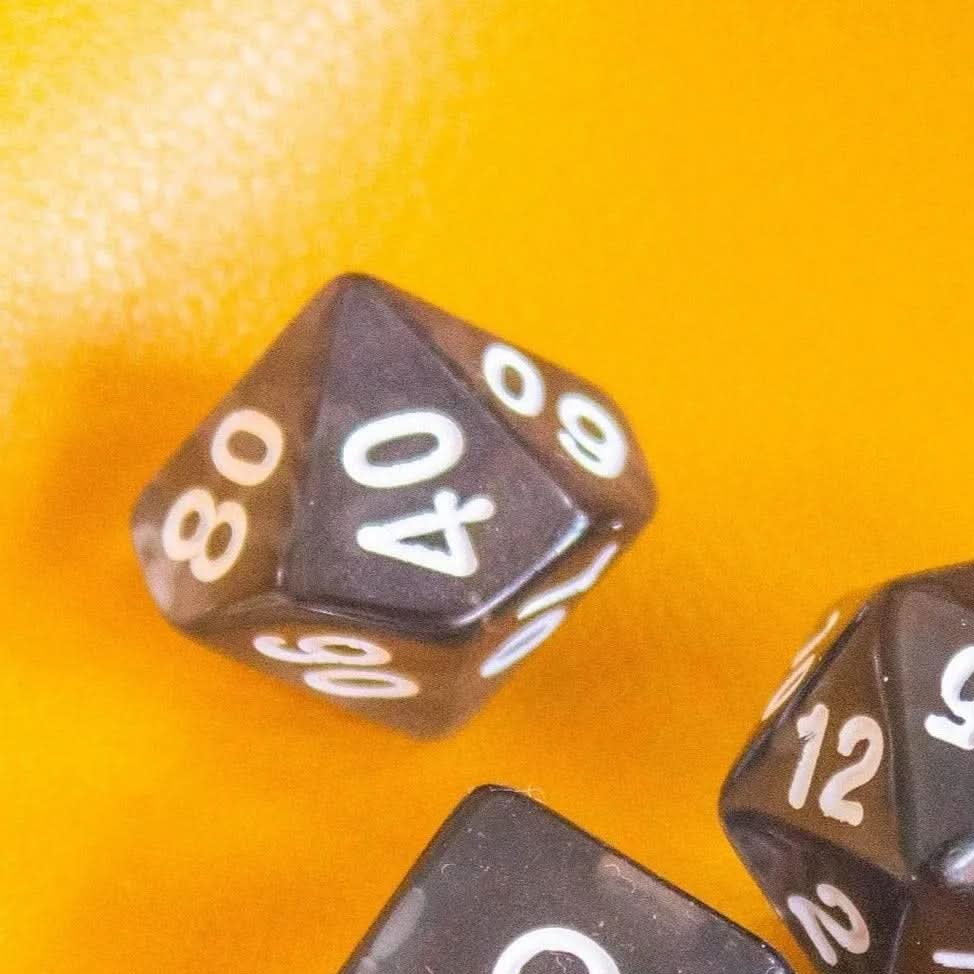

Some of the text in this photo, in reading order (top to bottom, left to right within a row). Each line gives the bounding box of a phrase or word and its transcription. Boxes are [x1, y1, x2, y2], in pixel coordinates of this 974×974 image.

[162, 408, 283, 583] 80
[342, 411, 494, 577] 40
[788, 704, 883, 826] 12
[788, 884, 869, 965] 2
